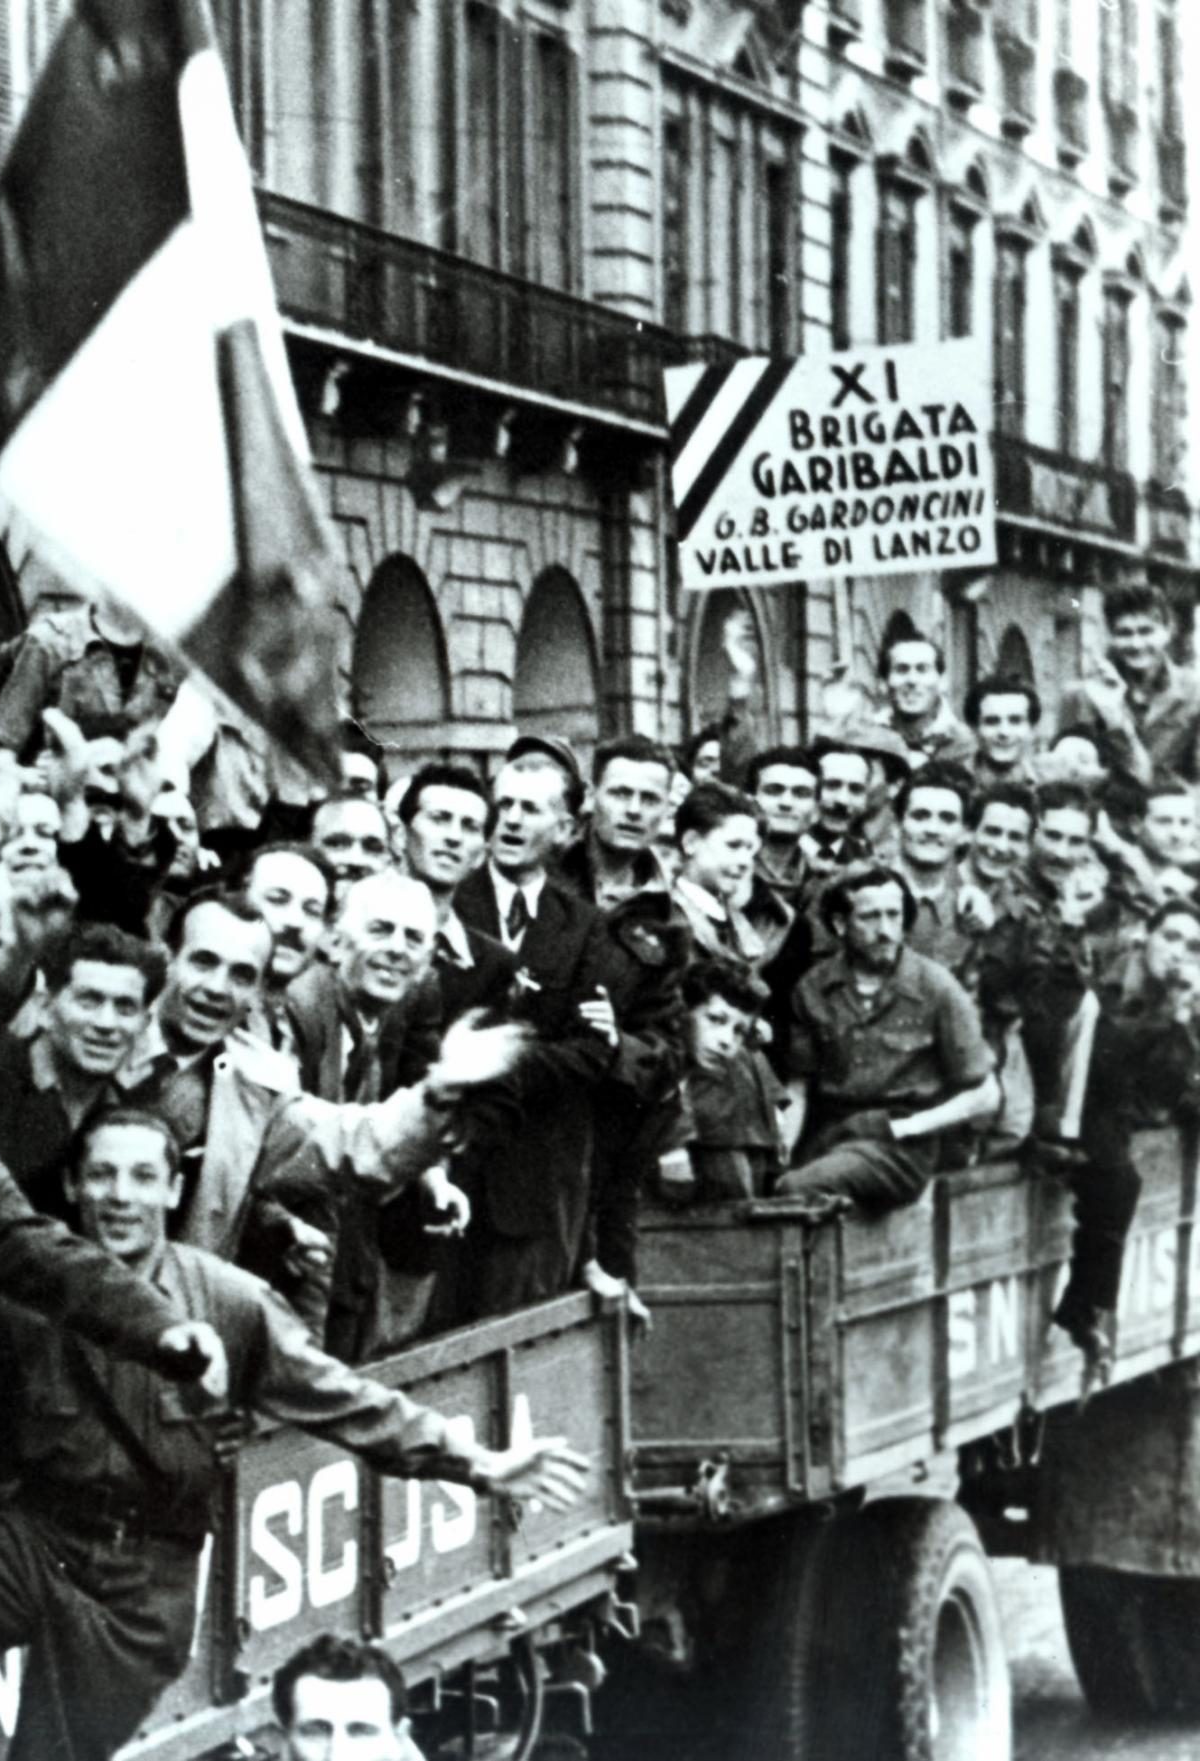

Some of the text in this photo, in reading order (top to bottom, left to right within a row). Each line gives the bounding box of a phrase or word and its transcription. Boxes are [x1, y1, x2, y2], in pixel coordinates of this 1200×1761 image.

[829, 358, 899, 409] XI
[788, 402, 978, 452] BRIGATA
[751, 442, 979, 499] GARIBALDI
[786, 488, 985, 535] GARDONCINI
[695, 525, 982, 575] VALLE DI LANZO
